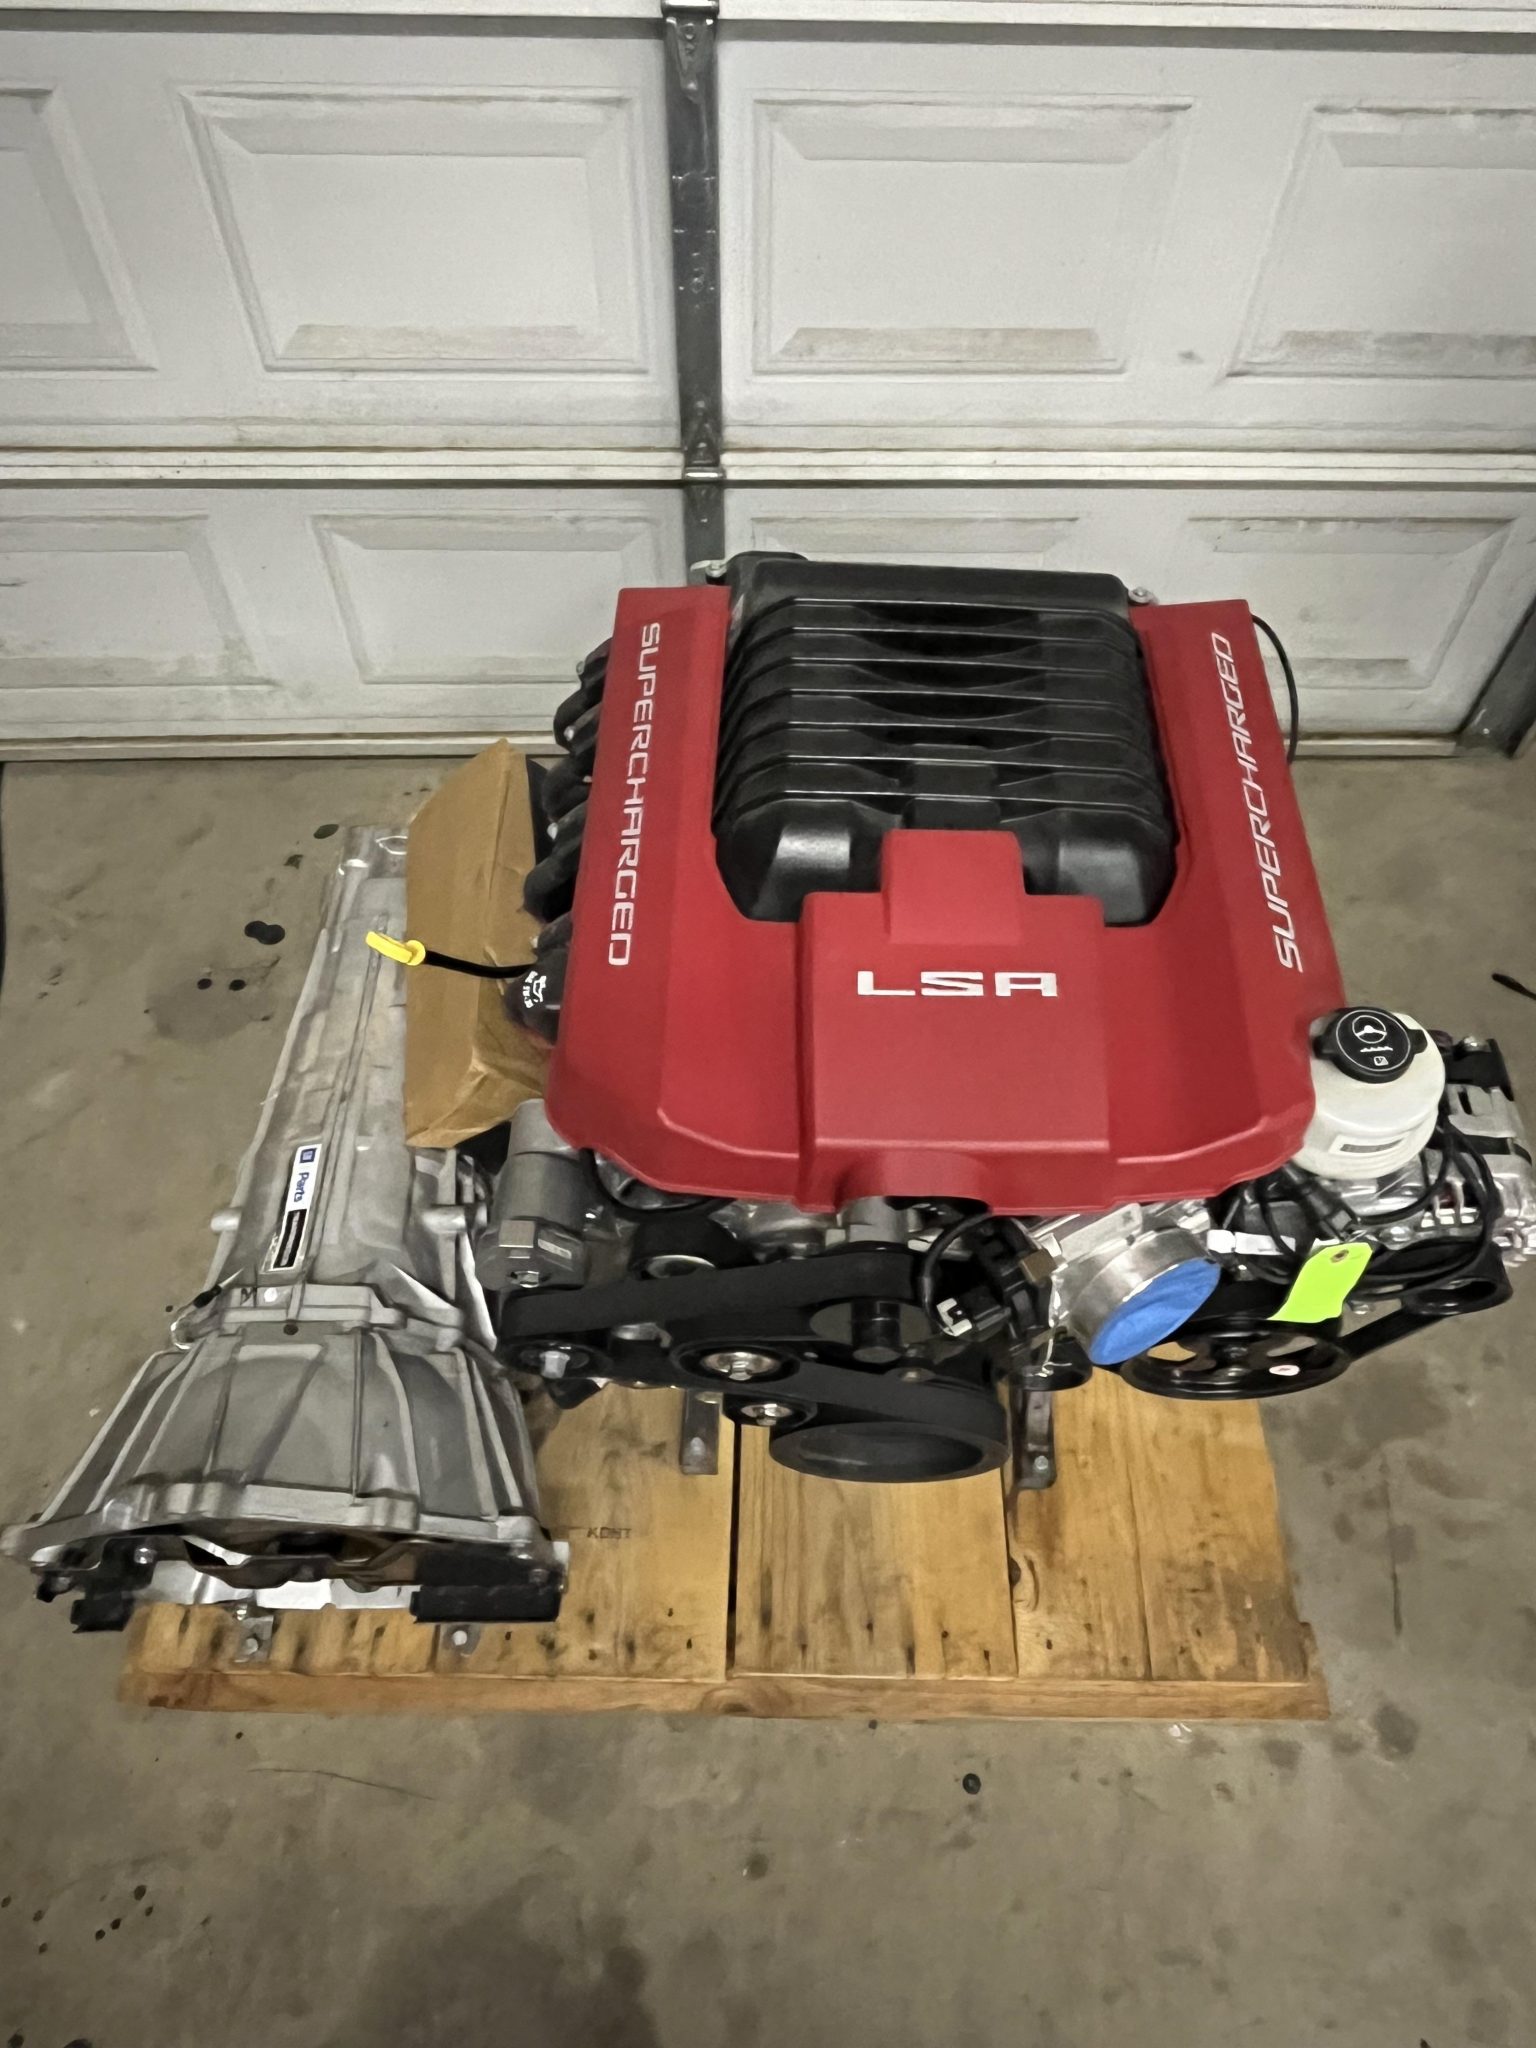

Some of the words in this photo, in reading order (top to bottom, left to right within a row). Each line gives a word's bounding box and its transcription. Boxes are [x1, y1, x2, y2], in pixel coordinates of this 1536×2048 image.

[609, 622, 660, 967] SUPERCHARGED
[1211, 633, 1303, 973] SUPERCHARGED
[857, 971, 1058, 997] LSA
[293, 1172, 310, 1203] Parts
